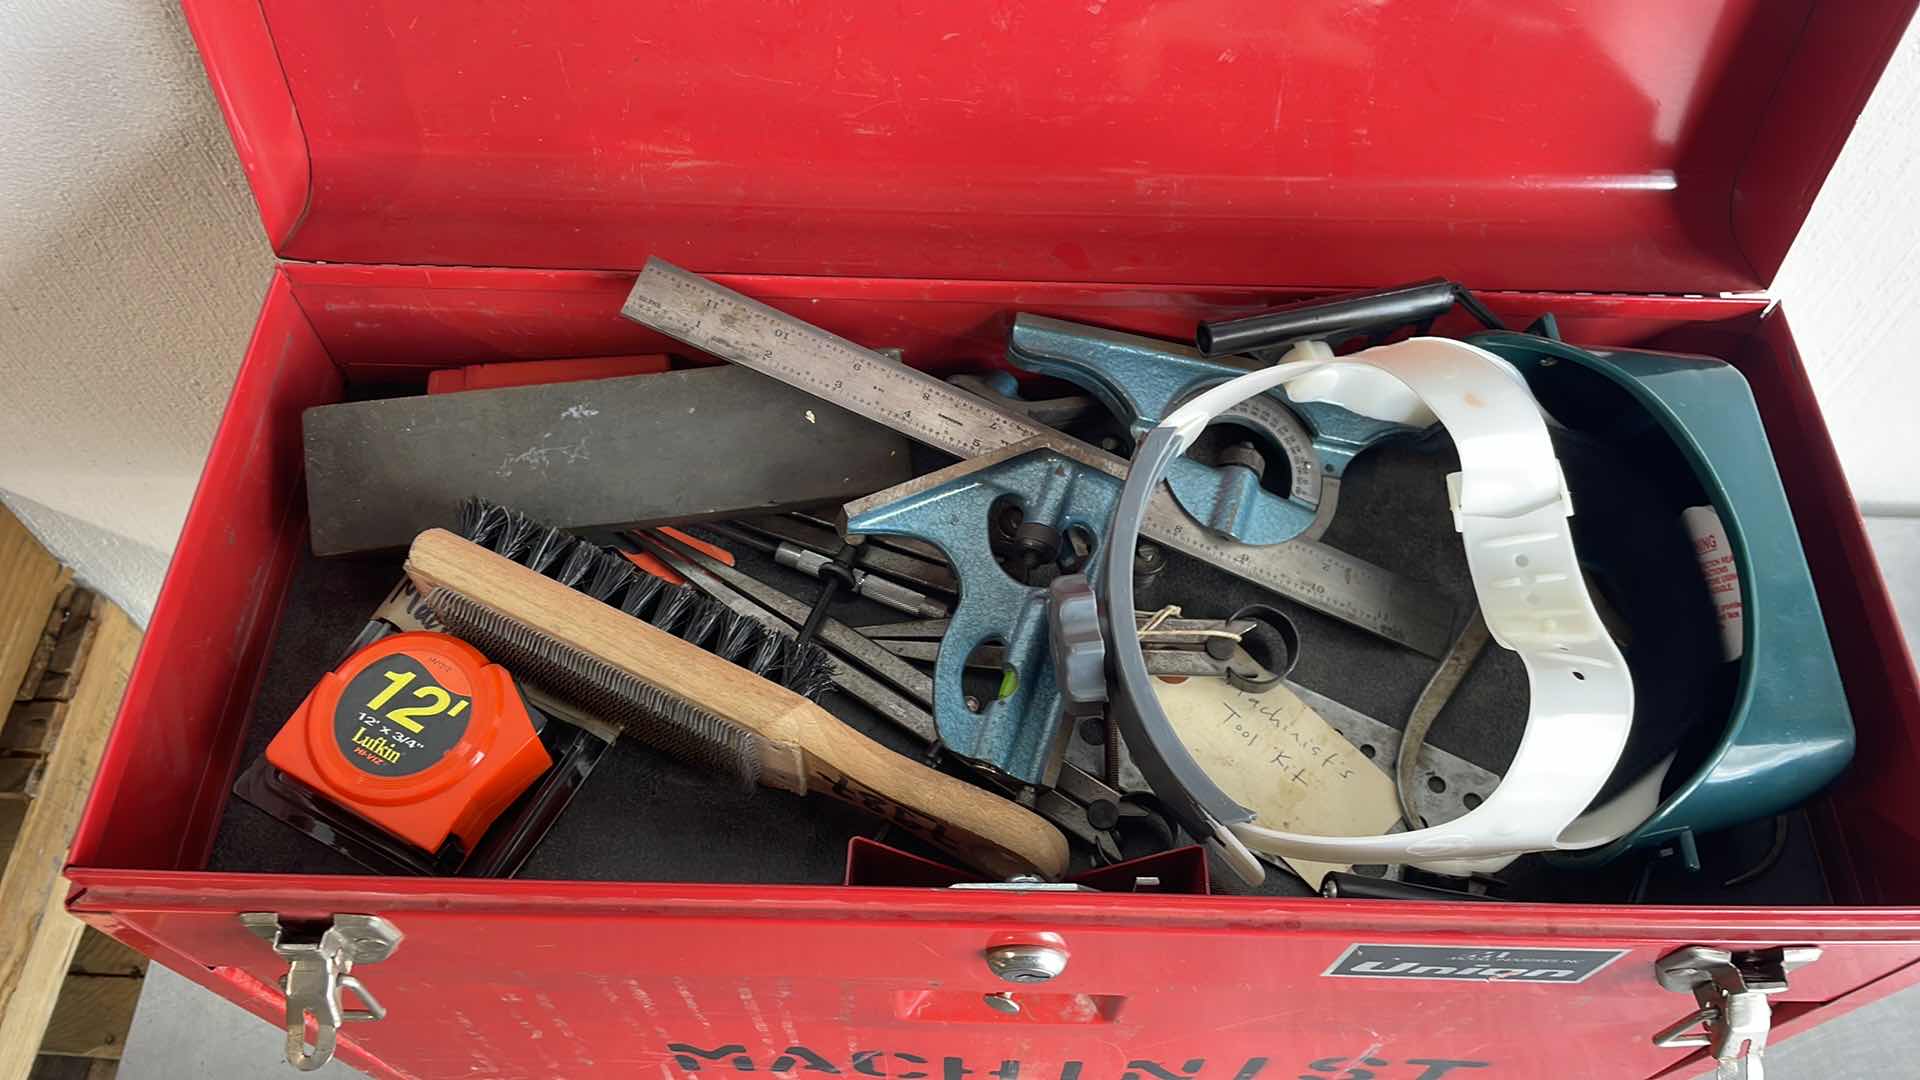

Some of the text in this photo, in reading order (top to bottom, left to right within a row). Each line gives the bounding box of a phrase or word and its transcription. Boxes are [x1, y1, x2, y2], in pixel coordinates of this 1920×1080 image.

[971, 438, 982, 448] 5
[367, 671, 469, 733] 12'
[352, 726, 401, 763] Lufkin
[358, 712, 381, 727] 12'
[392, 731, 425, 749] 3/4"
[1223, 702, 1308, 785] Tool Kit
[1238, 691, 1355, 779] achinist's
[1350, 961, 1576, 978] Union
[667, 1043, 1491, 1080] MACHINIST
